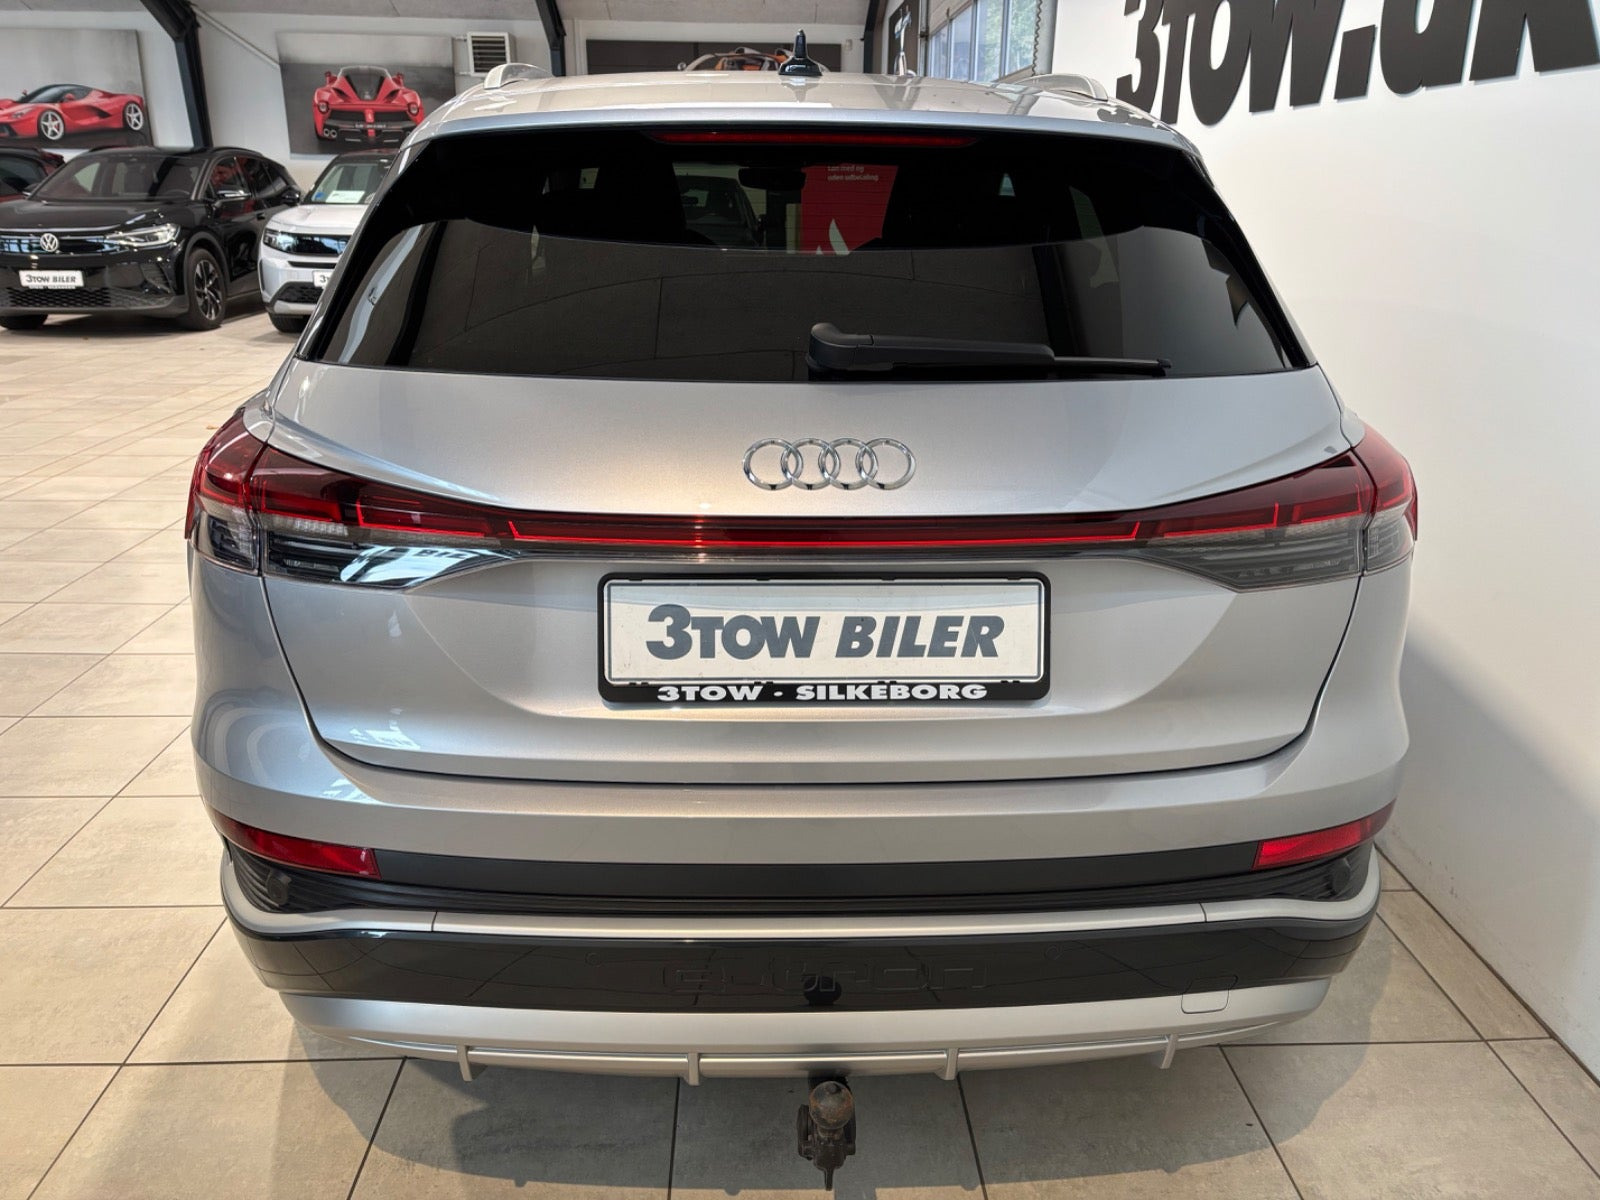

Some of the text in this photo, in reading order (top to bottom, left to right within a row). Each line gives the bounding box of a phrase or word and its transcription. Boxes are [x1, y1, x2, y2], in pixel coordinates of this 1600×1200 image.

[52, 275, 76, 283] BILER
[646, 604, 1005, 661] 3TOW BILER
[657, 685, 763, 701] 3TOW
[796, 684, 988, 701] SILKEBORG
